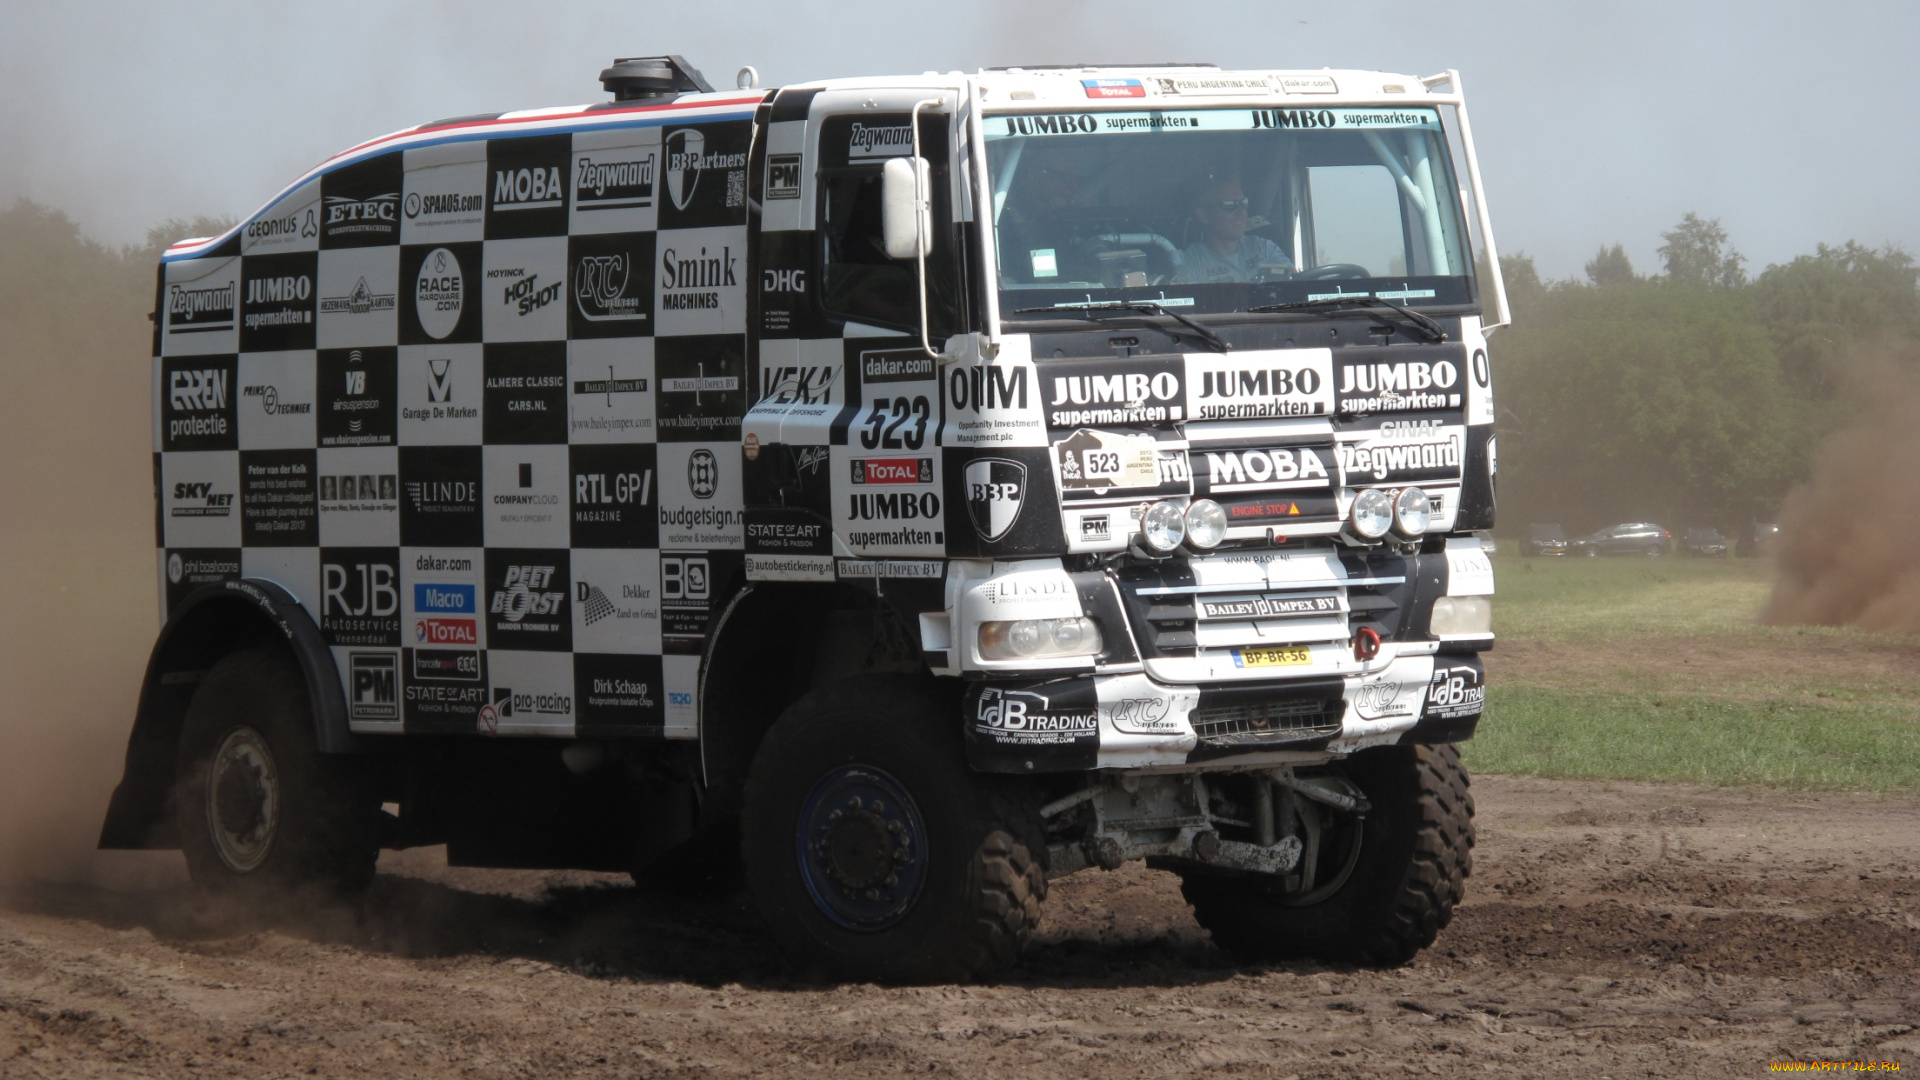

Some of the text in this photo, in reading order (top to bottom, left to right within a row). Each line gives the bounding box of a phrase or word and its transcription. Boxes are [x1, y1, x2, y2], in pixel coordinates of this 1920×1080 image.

[1177, 80, 1267, 89] PERU ARGENTINA CHILE
[1284, 77, 1332, 88] dakar.com
[1099, 88, 1132, 96] TOTAL
[1005, 114, 1187, 137] JUMBO supermarkten
[1251, 110, 1418, 129] JUMBO supermarkten
[851, 122, 914, 152] Zegwaard
[578, 153, 655, 196] Zegwaard
[768, 166, 798, 188] PM
[494, 166, 563, 203] MOBA
[325, 202, 397, 225] ETEC
[487, 268, 525, 278] HOYINCK
[662, 246, 737, 290] Smink
[246, 275, 312, 305] JUMBO
[419, 277, 460, 292] RACE
[504, 274, 538, 306] HOT
[579, 254, 623, 308] RTC
[764, 270, 805, 292] DHG
[170, 280, 234, 322] Zegwaard
[320, 297, 396, 315] HEZEMANS INDOOR KARTING
[435, 301, 460, 311] .COM
[518, 281, 562, 317] SHOT
[662, 292, 718, 310] MACHINES
[244, 308, 303, 331] supermarkten
[866, 358, 932, 376] dakar.com
[346, 371, 366, 395] VB
[486, 376, 564, 388] ALMERE CLASSIC
[584, 380, 644, 392] BAILEY IMPEX BV
[673, 378, 736, 390] BAILEY IMPEX BV
[764, 366, 832, 406] VEKA
[1199, 368, 1320, 398] JUMBO
[1340, 361, 1457, 393] JUMBO
[171, 369, 227, 411] ERREN
[1052, 372, 1179, 406] JUMBO
[244, 386, 311, 415] PRINS TECHNIEK
[333, 398, 379, 412] airsuspension
[508, 400, 548, 411] CARS.NL
[1200, 398, 1310, 419] supermarkten
[1341, 390, 1446, 413] supermarkten
[402, 406, 478, 422] Garage De Marken
[750, 408, 782, 416] SHIPPING
[1052, 404, 1166, 426] supermarkten
[171, 414, 227, 442] protectie
[572, 416, 652, 432] www.baileyimpex.com
[658, 414, 742, 430] www.baileyimpex.com
[860, 396, 930, 450] 523
[958, 419, 1040, 430] Opportunity Investment
[1380, 420, 1444, 439] GINAF
[322, 434, 391, 446] www.vbairsuspension.com
[956, 432, 1013, 444] Management plc
[1089, 452, 1120, 474] 523
[1204, 448, 1328, 485] MOBA
[1342, 435, 1460, 480] Zegwaard
[248, 464, 308, 475] Peter van der Kolk
[868, 463, 916, 479] TOTAL
[174, 482, 213, 500] SKY
[267, 494, 284, 502] Dakar
[423, 482, 476, 502] LINDE
[576, 474, 612, 504] RTL
[972, 483, 1018, 502] BBP
[206, 494, 234, 506] NET
[494, 495, 558, 505] COMPANYCLOUD
[848, 492, 940, 520] JUMBO
[576, 510, 621, 522] MAGAZINE
[1232, 504, 1288, 516] ENGINE STOP
[748, 524, 821, 538] STATE OF ART
[1082, 520, 1108, 535] PM
[668, 532, 741, 546] reclame beletteringen
[790, 540, 813, 548] PASSION
[850, 526, 932, 550] supermarkten
[416, 554, 471, 572] dakar.com
[755, 560, 834, 574] autobestickering.nl
[840, 563, 939, 576] BAILEY IMPEX BV
[503, 566, 556, 589] PEET
[322, 564, 398, 617] RJB
[623, 584, 650, 599] Dekker
[1000, 581, 1070, 596] LINDE
[426, 589, 464, 608] Macro
[1207, 596, 1335, 616] BAILEY IMPEX BV
[616, 608, 631, 619] Zand
[640, 608, 658, 620] Grind
[324, 617, 399, 631] Autoservice
[428, 622, 475, 641] TOTAL
[497, 622, 522, 631] BANDEN
[550, 624, 560, 632] BV
[336, 634, 387, 644] Veenendaal
[1246, 649, 1308, 664] BP-BR-56
[354, 669, 395, 704] PM
[406, 686, 485, 702] STATE OF ART
[594, 679, 647, 698] Dirk Schaap
[418, 704, 476, 714] FASHION PASSION
[514, 692, 571, 715] pro-racing
[639, 698, 654, 708] Chips
[1027, 714, 1097, 730] TRADING
[1115, 698, 1163, 729] RTC
[995, 736, 1076, 745] WWW.JBTRADING.COM
